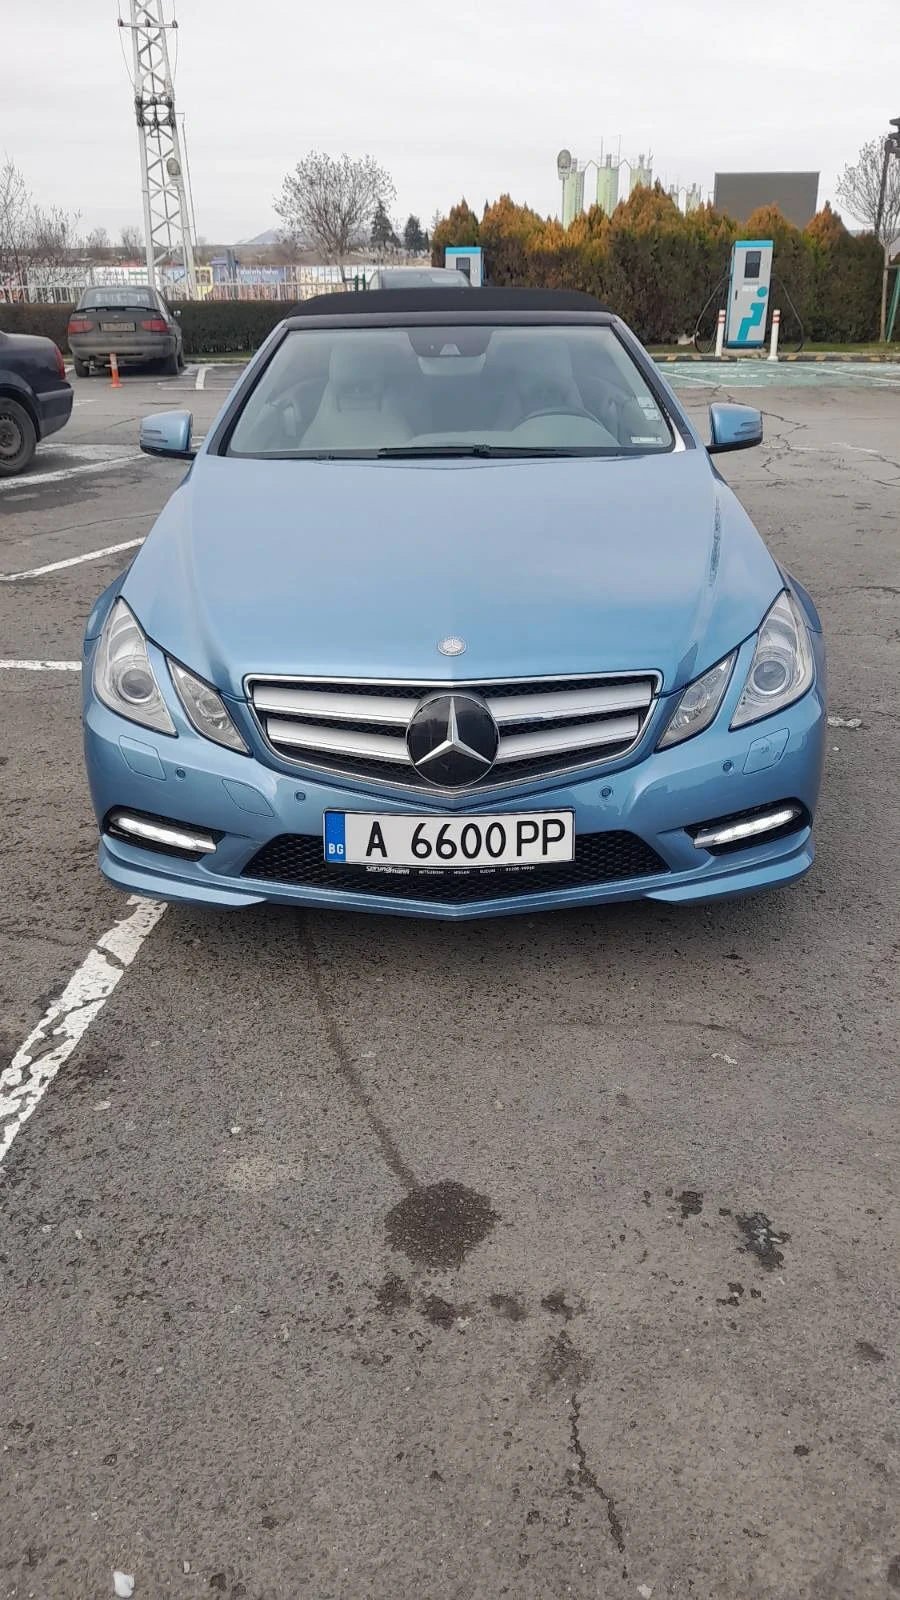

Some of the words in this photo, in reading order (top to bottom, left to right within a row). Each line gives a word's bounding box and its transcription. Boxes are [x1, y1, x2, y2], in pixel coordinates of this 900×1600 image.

[328, 842, 344, 855] BG
[365, 821, 388, 858] A
[410, 822, 506, 859] 6600
[516, 818, 566, 857] PP
